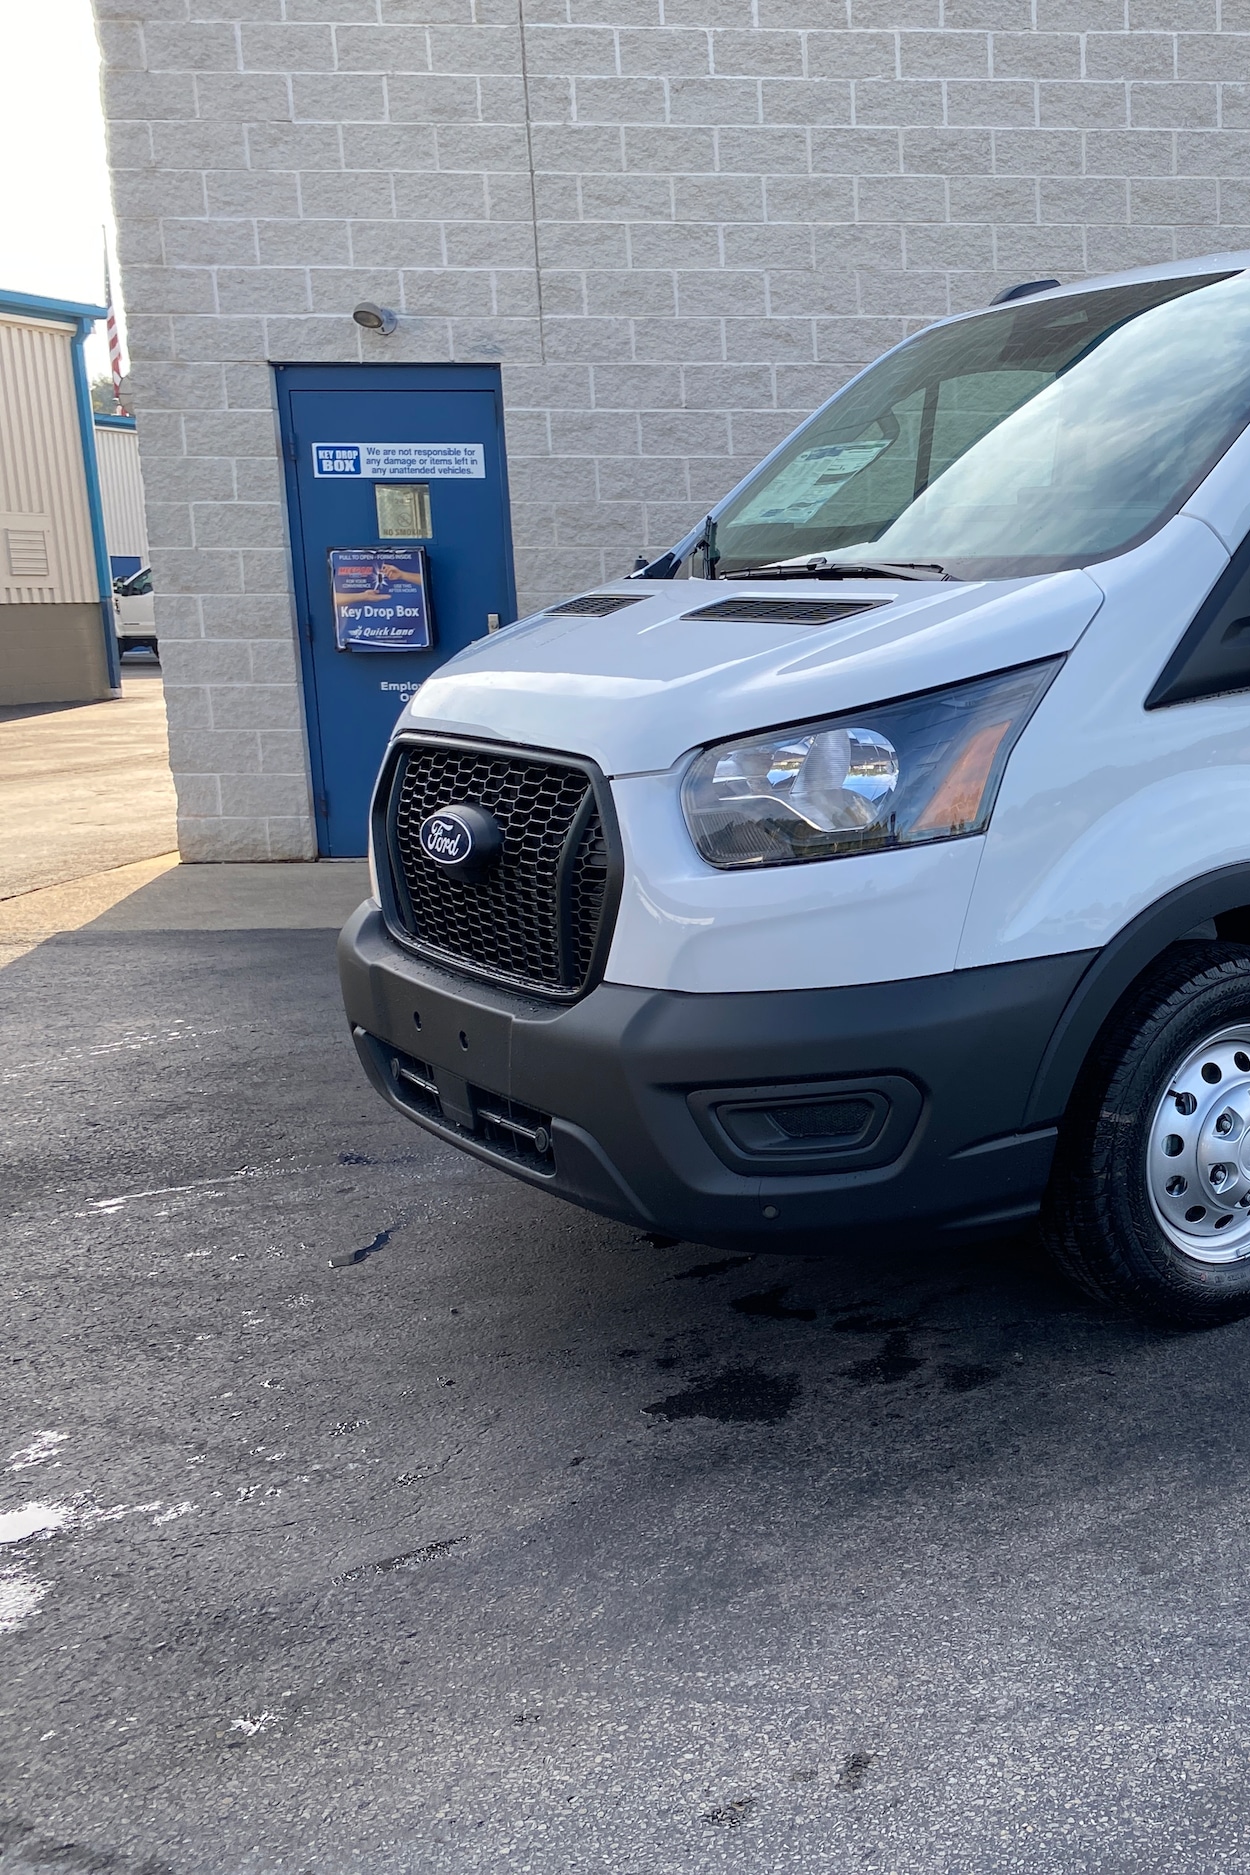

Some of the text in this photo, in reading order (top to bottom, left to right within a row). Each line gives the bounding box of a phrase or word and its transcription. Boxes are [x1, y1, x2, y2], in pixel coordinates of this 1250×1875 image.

[318, 450, 359, 460] KEY DROP
[366, 447, 381, 456] We
[398, 448, 412, 456] not
[414, 447, 462, 458] responsible
[464, 447, 476, 456] for
[322, 460, 356, 472] BOX
[366, 458, 381, 467] any
[383, 456, 417, 467] damage
[429, 457, 453, 465] items
[454, 457, 468, 465] left
[470, 457, 478, 465] in
[371, 466, 474, 476] any unattended vehicles.
[341, 606, 419, 620] Key Drop Box
[364, 627, 415, 636] Quick Lane
[427, 820, 462, 857] Ford
